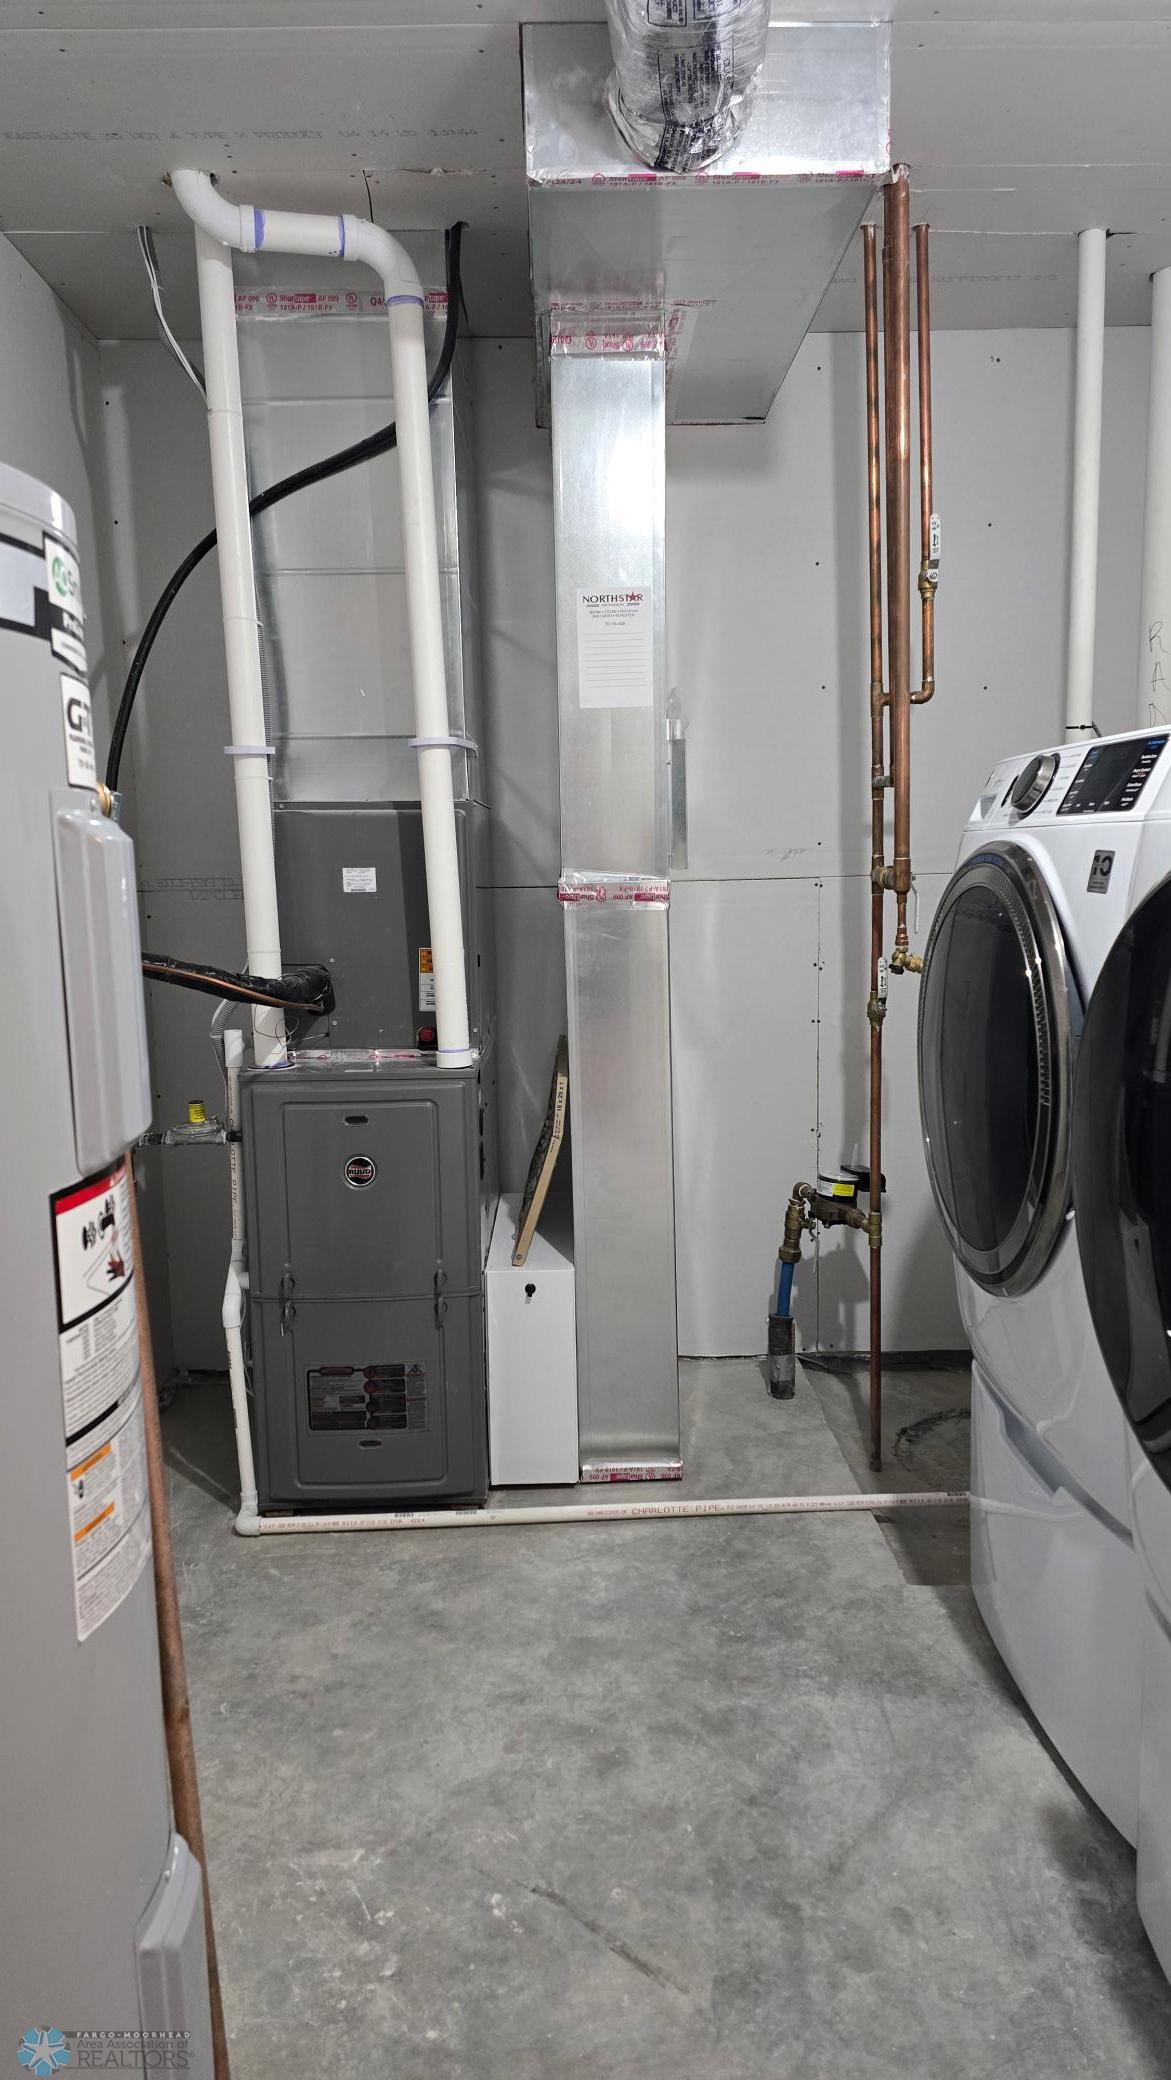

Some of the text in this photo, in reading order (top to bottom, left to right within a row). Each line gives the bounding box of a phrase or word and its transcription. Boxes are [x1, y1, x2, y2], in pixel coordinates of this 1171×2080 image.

[582, 592, 644, 604] NORTHSTAR
[632, 1505, 689, 1516] CHARLOTTE
[695, 1504, 720, 1513] PIPE
